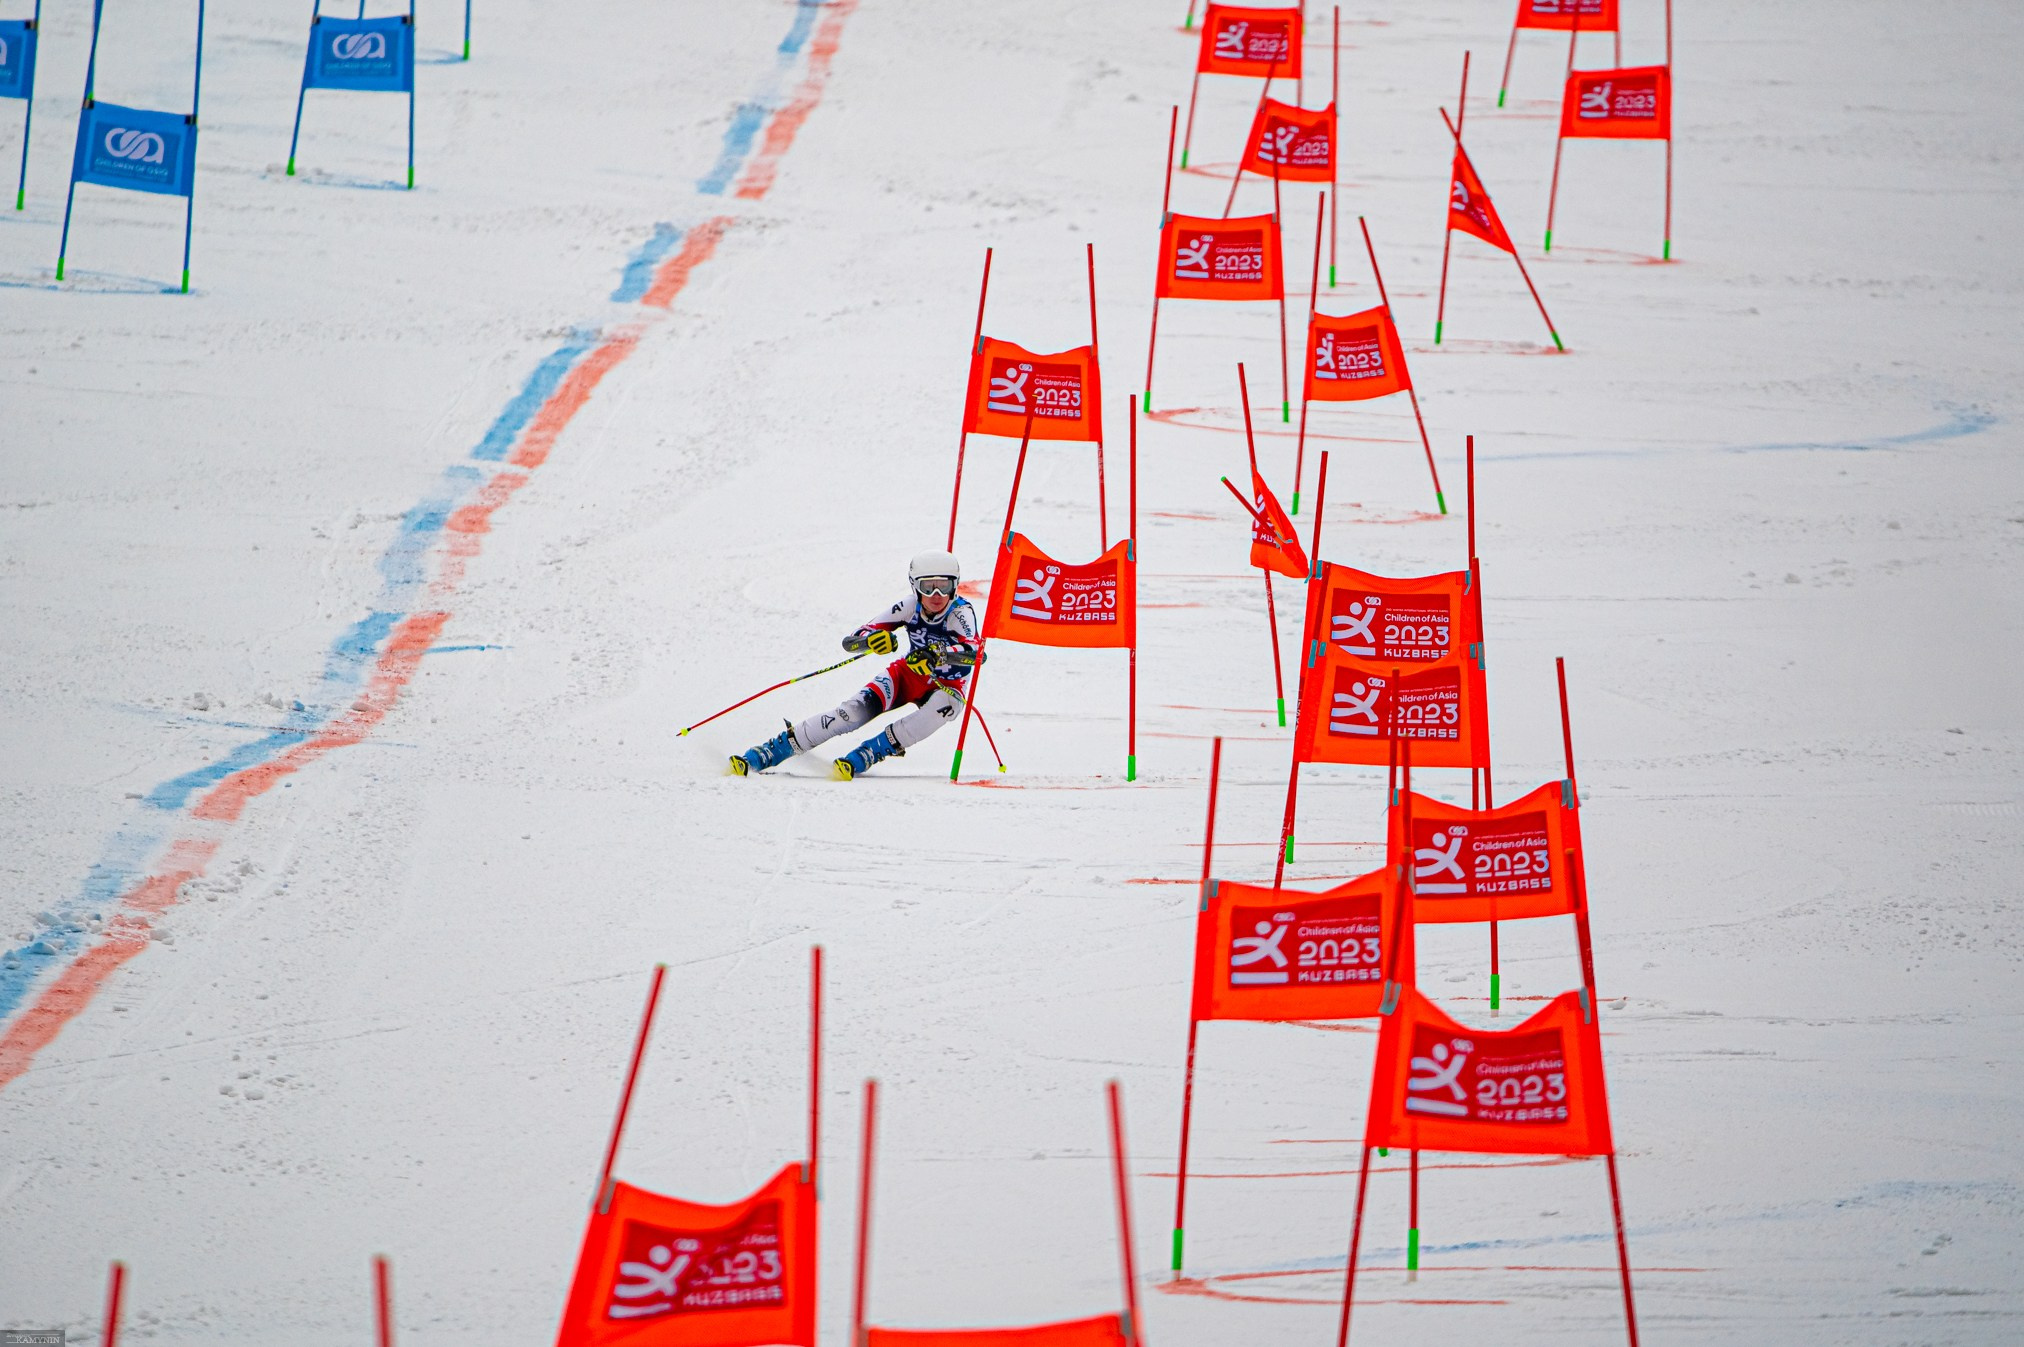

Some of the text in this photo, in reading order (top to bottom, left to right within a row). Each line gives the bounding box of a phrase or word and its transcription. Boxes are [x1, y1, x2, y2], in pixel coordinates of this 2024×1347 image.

[1293, 142, 1329, 156] 2023
[1215, 255, 1262, 270] 2023
[1338, 351, 1382, 370] 2023
[1034, 378, 1061, 387] Children
[1034, 387, 1081, 407] 2023
[1061, 590, 1116, 611] 2023
[1059, 612, 1116, 621] KUZBASS
[1384, 613, 1449, 623] Children of Asia
[1384, 624, 1450, 646] 2023
[1428, 692, 1438, 701] of
[1438, 691, 1458, 700] Asia
[1472, 837, 1547, 851] Children of Asia
[1474, 850, 1550, 878] 2023
[1476, 877, 1551, 892] KUZBASS
[1298, 937, 1381, 966] 2023
[1298, 968, 1381, 982] KUZBASS
[1476, 1072, 1566, 1106] 2023
